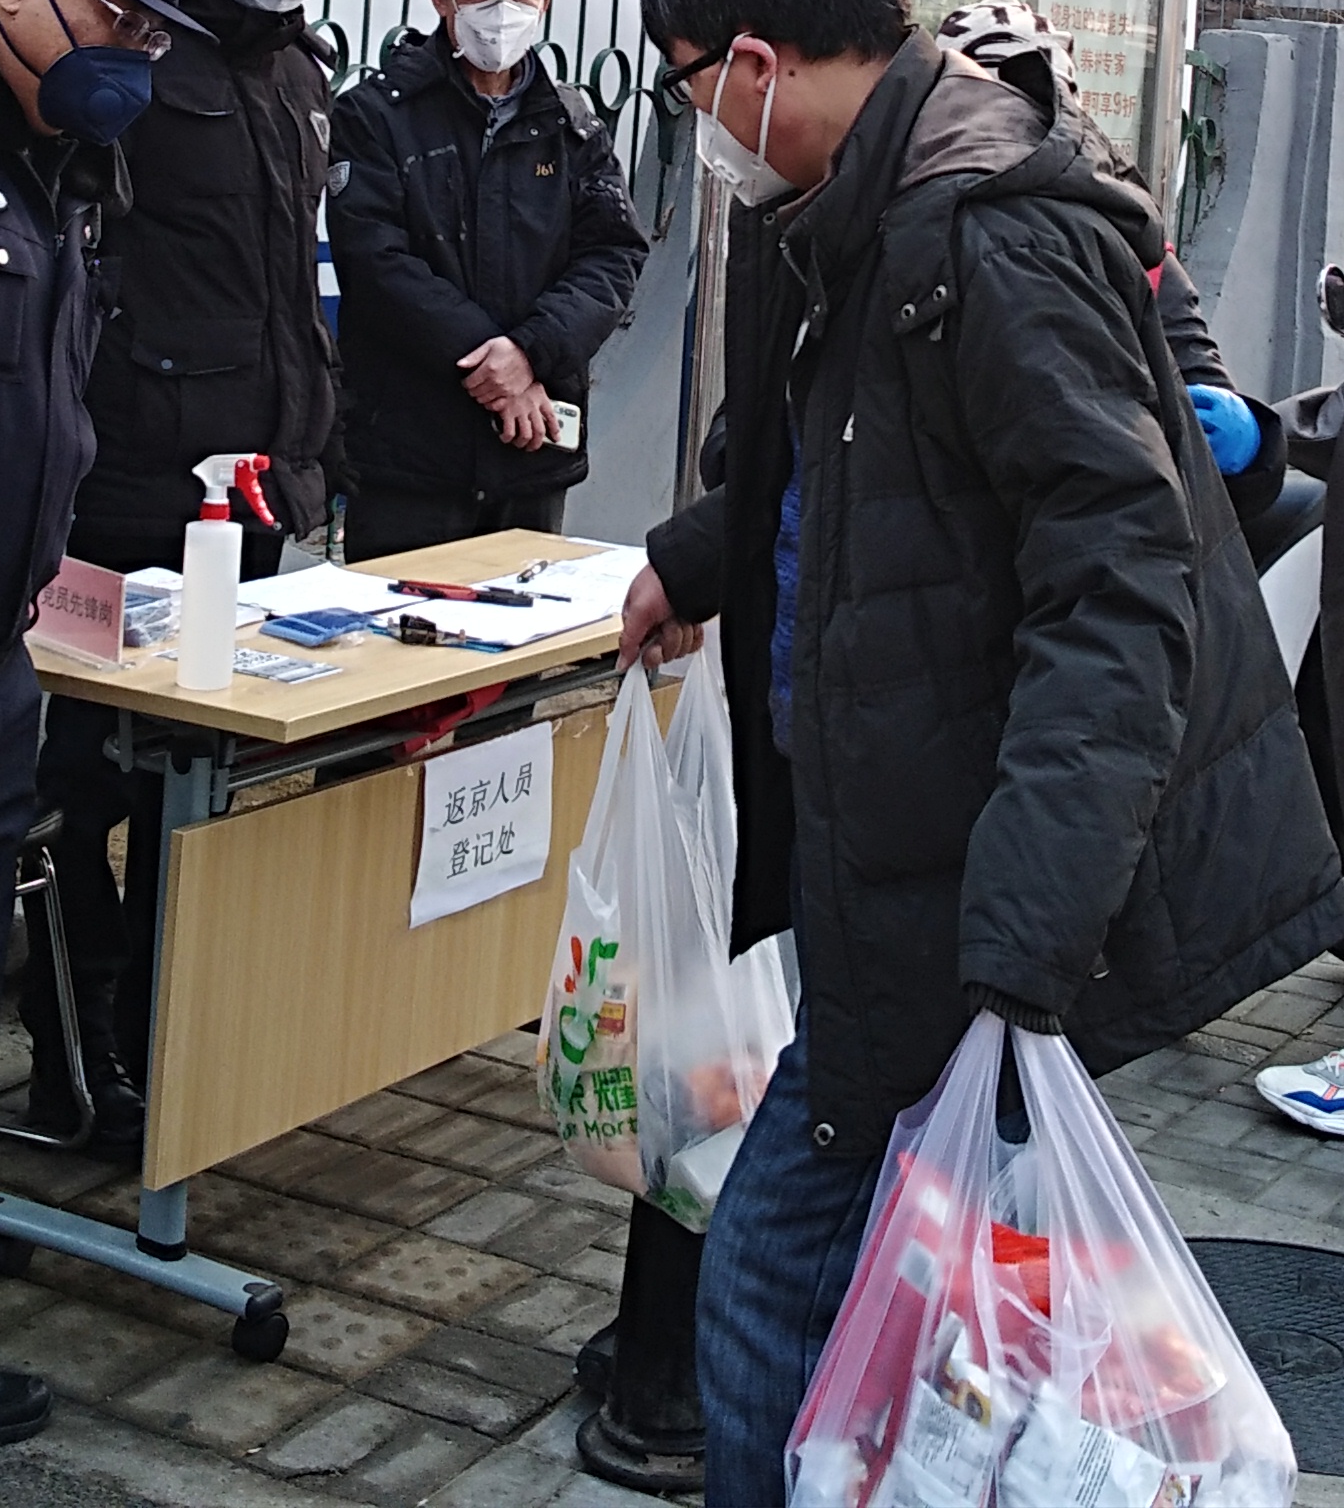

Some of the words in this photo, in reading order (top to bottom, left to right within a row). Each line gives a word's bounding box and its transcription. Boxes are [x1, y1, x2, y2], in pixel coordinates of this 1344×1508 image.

[41, 584, 113, 628] 党员先锋岗
[442, 761, 533, 828] 返京人员
[446, 821, 516, 880] 登记处
